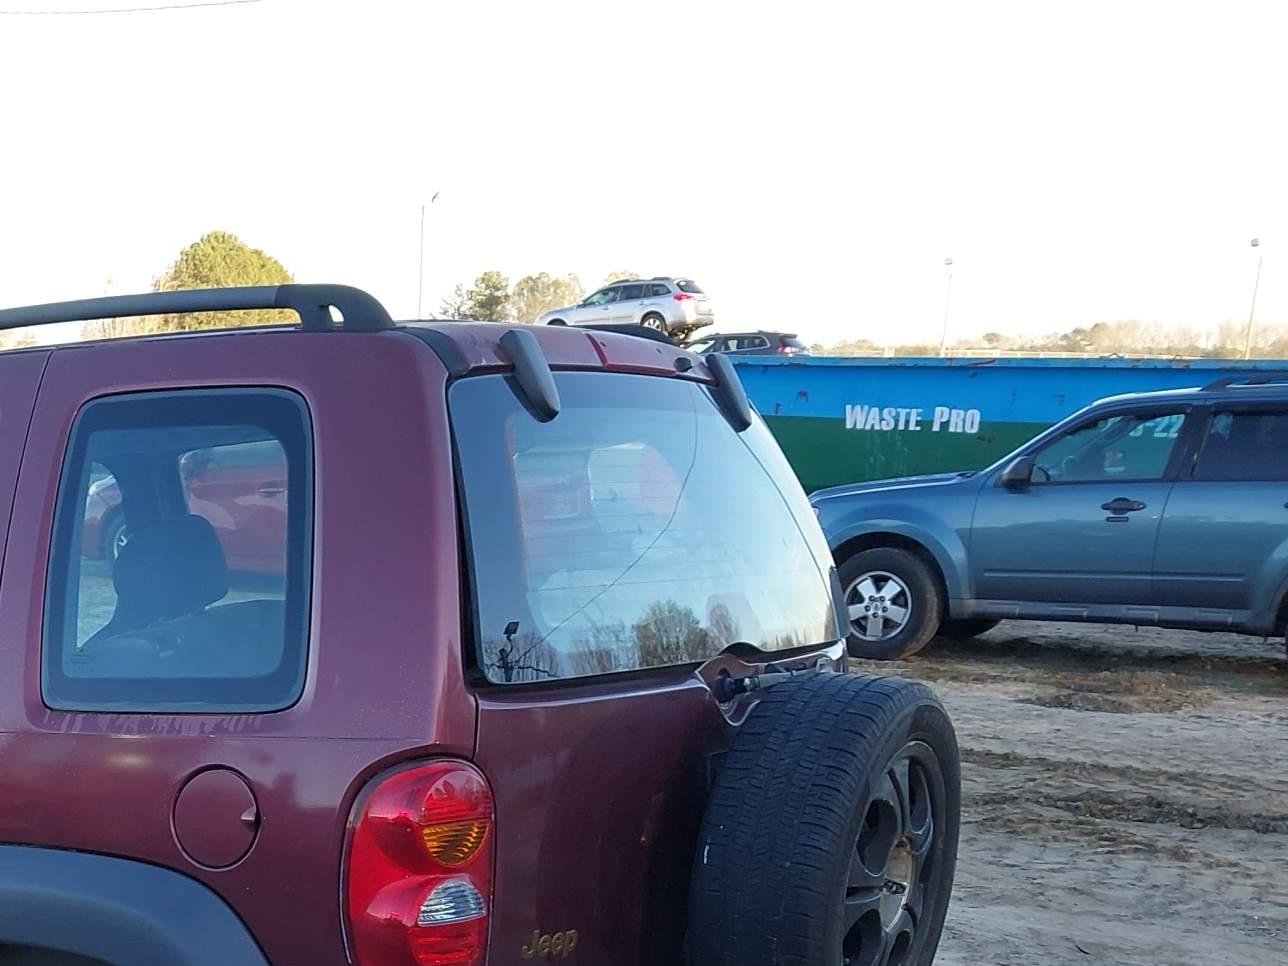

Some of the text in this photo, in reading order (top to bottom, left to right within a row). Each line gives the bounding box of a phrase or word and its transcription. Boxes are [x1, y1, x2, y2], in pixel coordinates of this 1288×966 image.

[845, 404, 981, 434] WASTE PRO
[521, 929, 579, 960] Jeep
